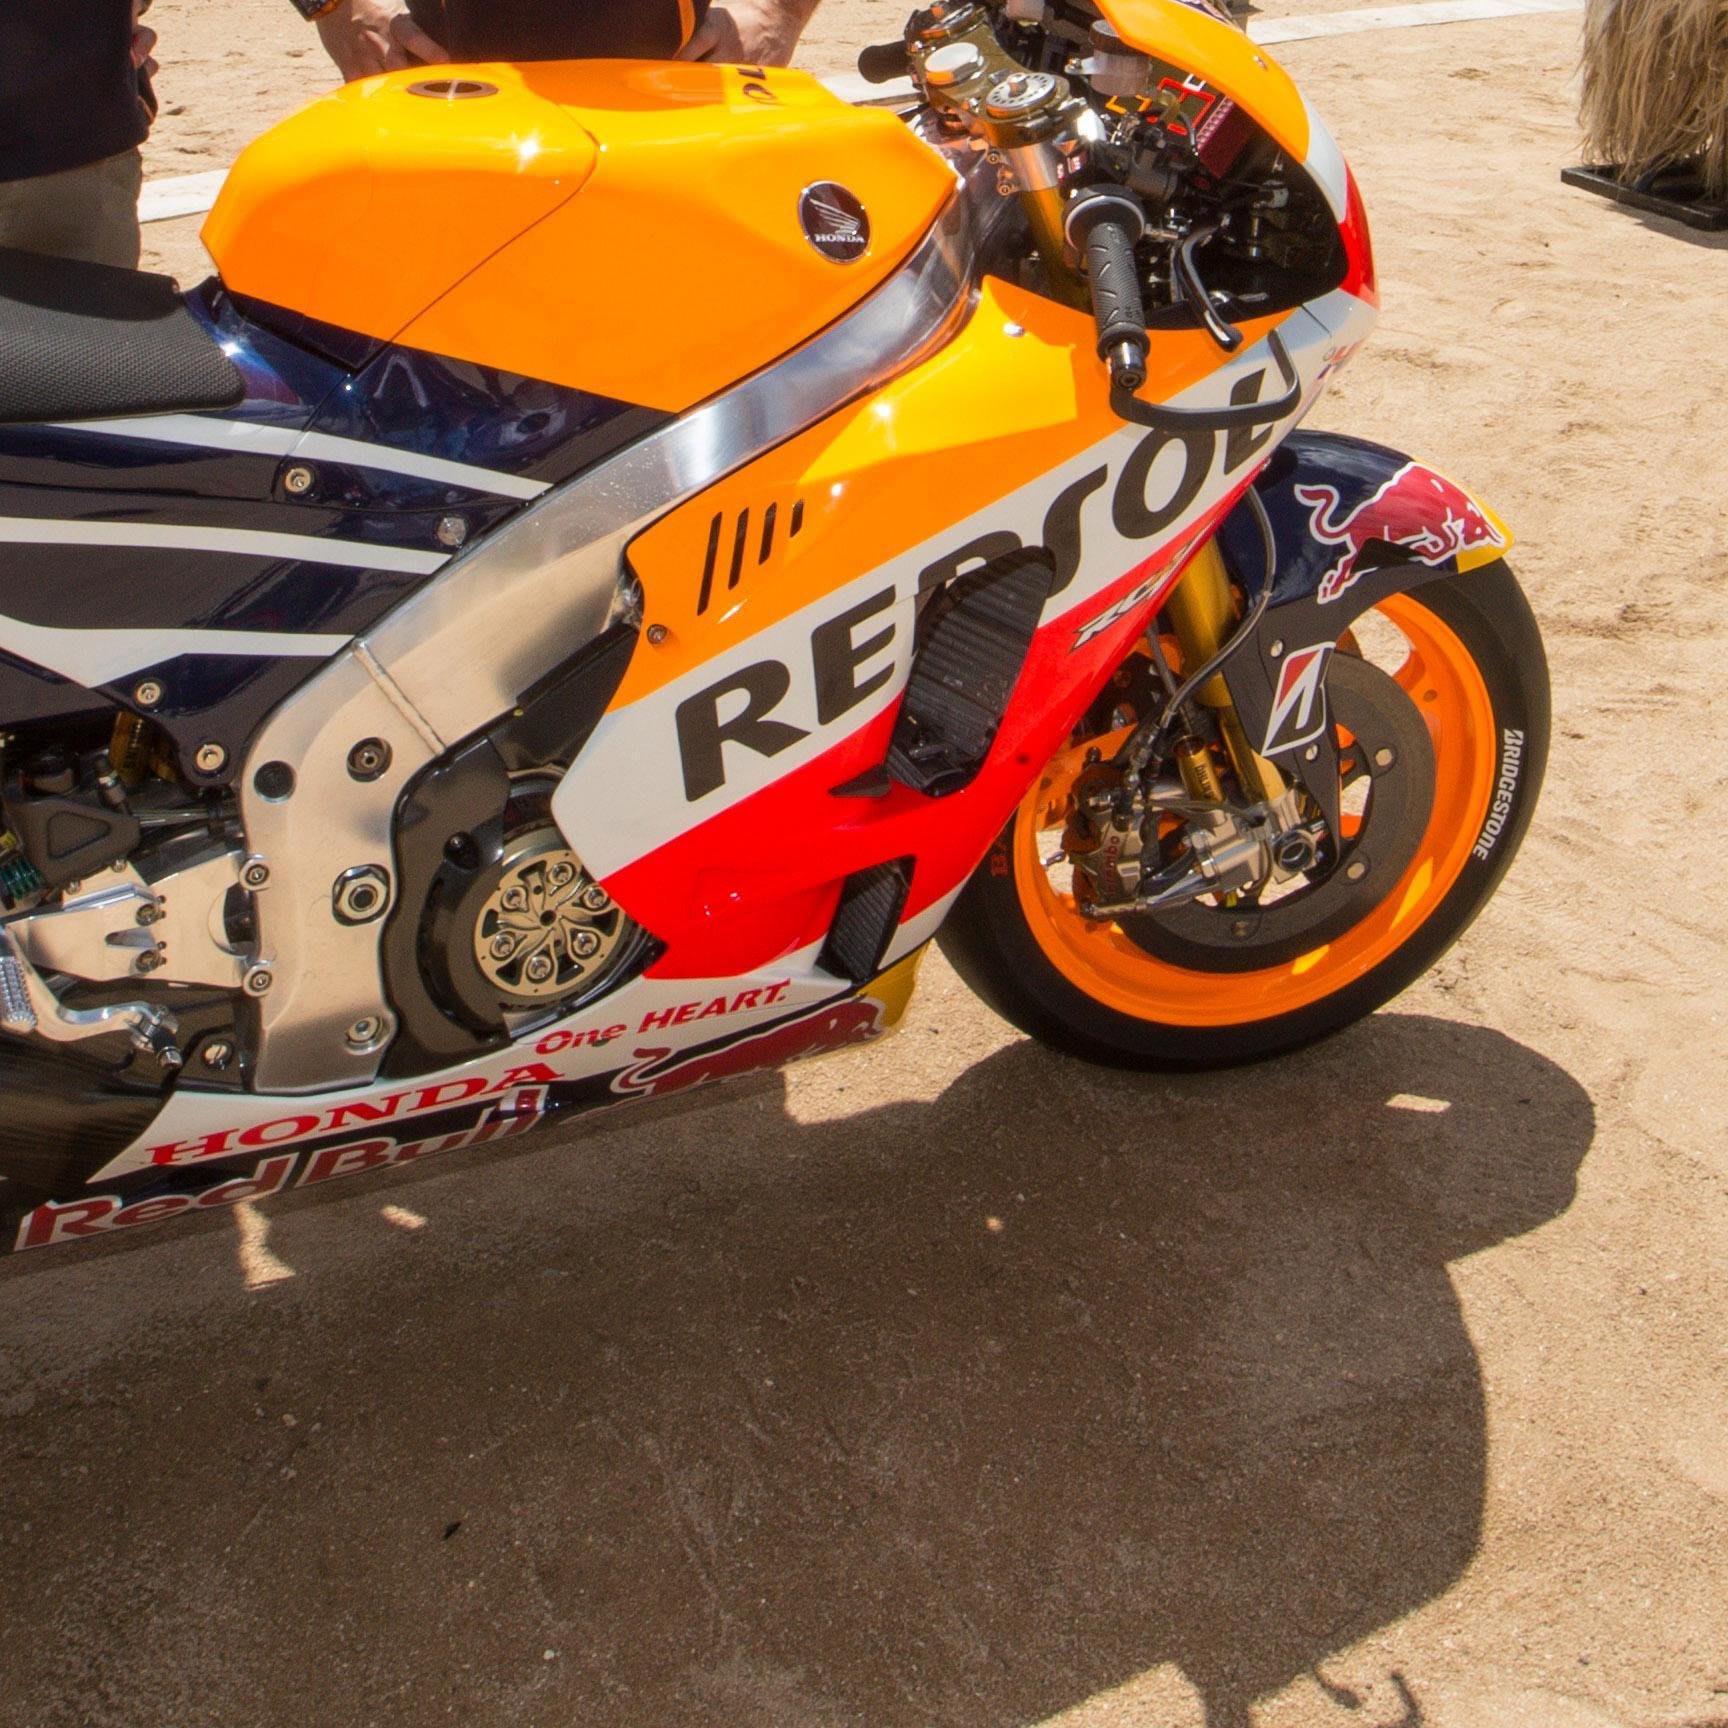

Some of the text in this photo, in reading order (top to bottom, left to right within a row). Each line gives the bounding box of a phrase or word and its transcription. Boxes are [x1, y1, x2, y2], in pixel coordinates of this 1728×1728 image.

[814, 233, 865, 244] HONDA
[1472, 728, 1524, 861] BRIDGESTONE
[534, 977, 792, 1056] One HEART.
[144, 1061, 566, 1167] HONDA
[14, 1083, 550, 1253] Red Bull
